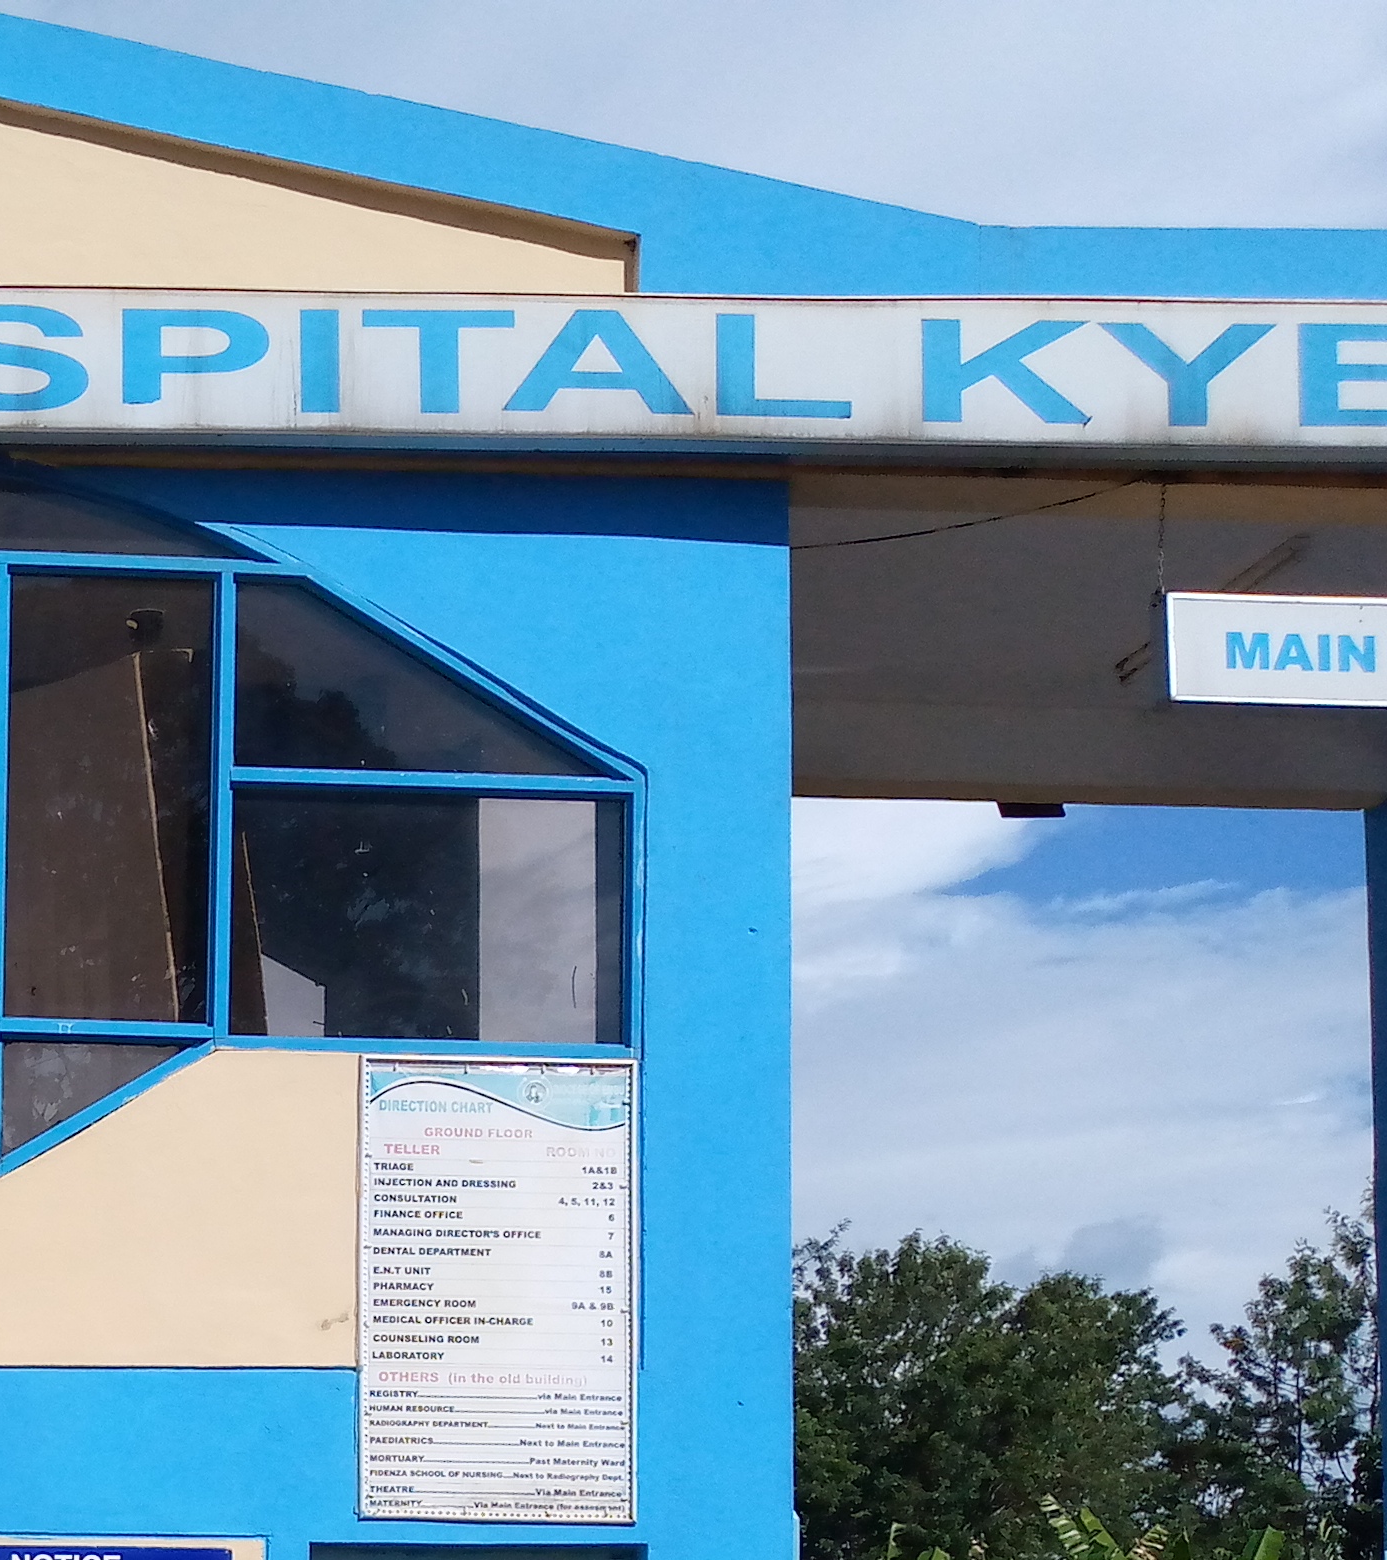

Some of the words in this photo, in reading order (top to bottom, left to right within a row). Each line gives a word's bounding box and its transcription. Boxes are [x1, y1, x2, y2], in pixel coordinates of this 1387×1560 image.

[1226, 632, 1375, 673] MAIN
[379, 1100, 447, 1112] DIRECTION
[451, 1102, 493, 1114] CHART
[425, 1128, 483, 1138] GROUND
[487, 1128, 533, 1138] FLOOR
[385, 1144, 440, 1155] TELLER
[374, 1162, 413, 1171] TRIAGE
[374, 1178, 432, 1187] INJECTION
[435, 1179, 459, 1187] AND
[461, 1180, 516, 1188] DRESSING
[374, 1194, 457, 1204] CONSULTATION
[374, 1210, 421, 1218] FINANCE
[424, 1210, 463, 1219] OFFICE
[373, 1229, 432, 1238] MANAGING
[435, 1230, 499, 1238] DIRECTOR'S
[503, 1230, 541, 1239] OFFICE
[373, 1248, 415, 1256] DENTAL
[419, 1248, 491, 1256] DEPARTMENT
[405, 1267, 431, 1275] UNIT
[373, 1282, 433, 1291] PHARMACY
[373, 1300, 441, 1308] EMERGENCY
[444, 1300, 476, 1308] ROOM
[373, 1316, 421, 1324] MEDICAL
[425, 1317, 471, 1325] OFFICER
[474, 1318, 533, 1326] IN-CHARGE
[601, 1320, 613, 1328] 10
[373, 1335, 444, 1344] COUNSELING
[447, 1336, 479, 1344] ROOM
[373, 1352, 445, 1360] LABORATORY
[379, 1372, 439, 1382] OTHERS
[449, 1372, 467, 1384] (in
[471, 1374, 494, 1384] the
[499, 1374, 521, 1384] old
[370, 1390, 418, 1398] REGISTRY
[581, 1394, 622, 1402] Entrance
[370, 1420, 430, 1428] RADIOGRAPHY
[370, 1436, 433, 1444] PAEDIATRICS
[557, 1440, 580, 1448] Main
[583, 1440, 625, 1448] Entrance
[553, 1458, 597, 1466] Maternity
